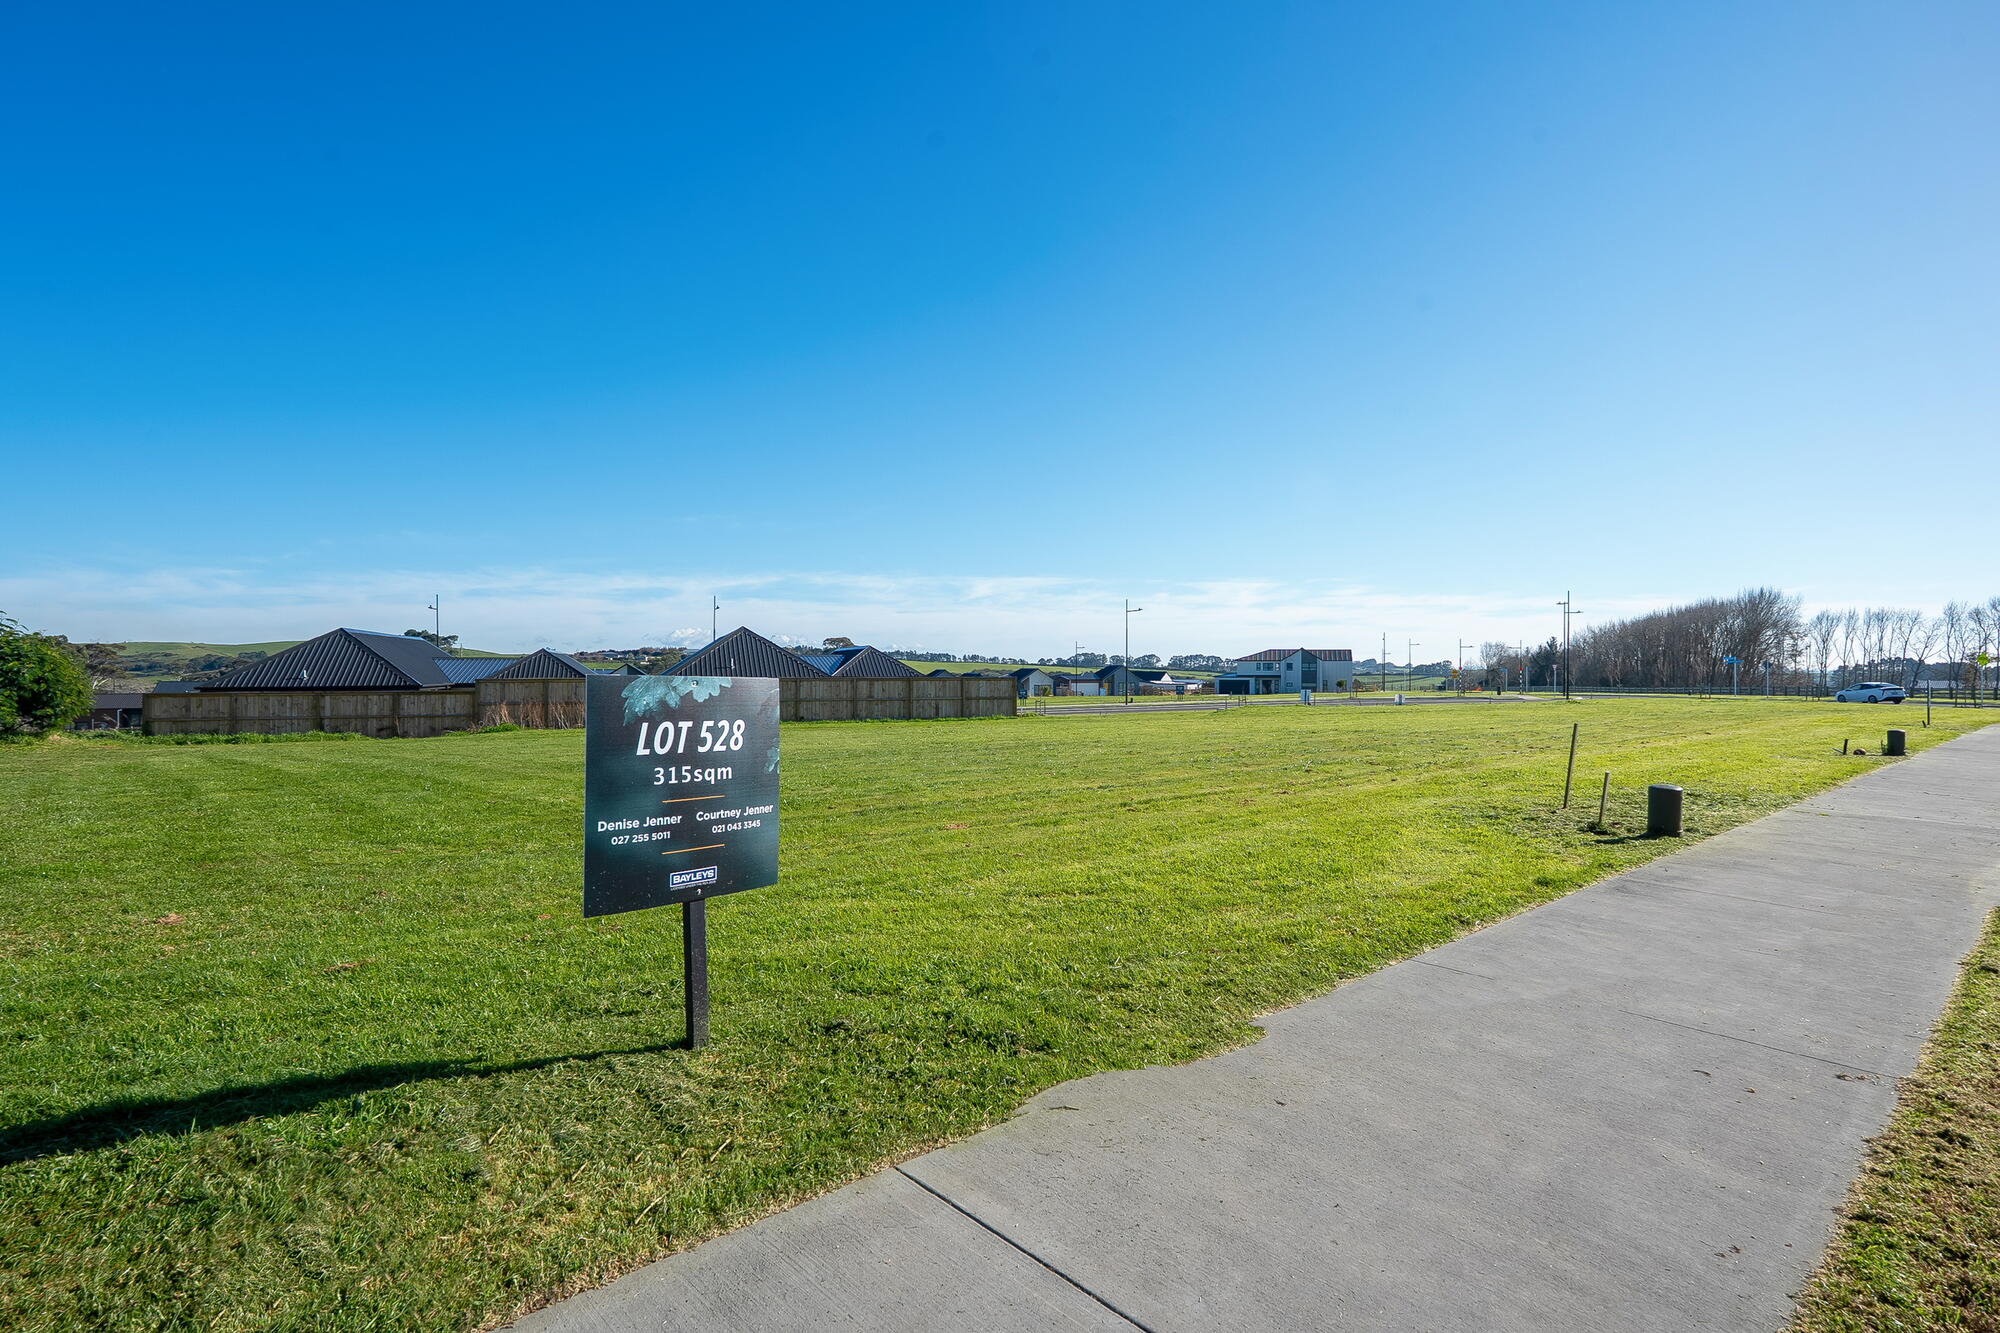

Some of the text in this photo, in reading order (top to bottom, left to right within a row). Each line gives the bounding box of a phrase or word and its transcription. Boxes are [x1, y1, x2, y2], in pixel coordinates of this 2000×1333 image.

[636, 719, 746, 756] LOT 528
[653, 765, 733, 785] 315sqm
[695, 803, 774, 822] Courtney Jenner
[597, 814, 682, 832] Denise Jenner
[712, 819, 761, 834] 021 043 3345
[611, 831, 671, 845] 027 255 5011
[673, 870, 714, 884] BAYLEYS
